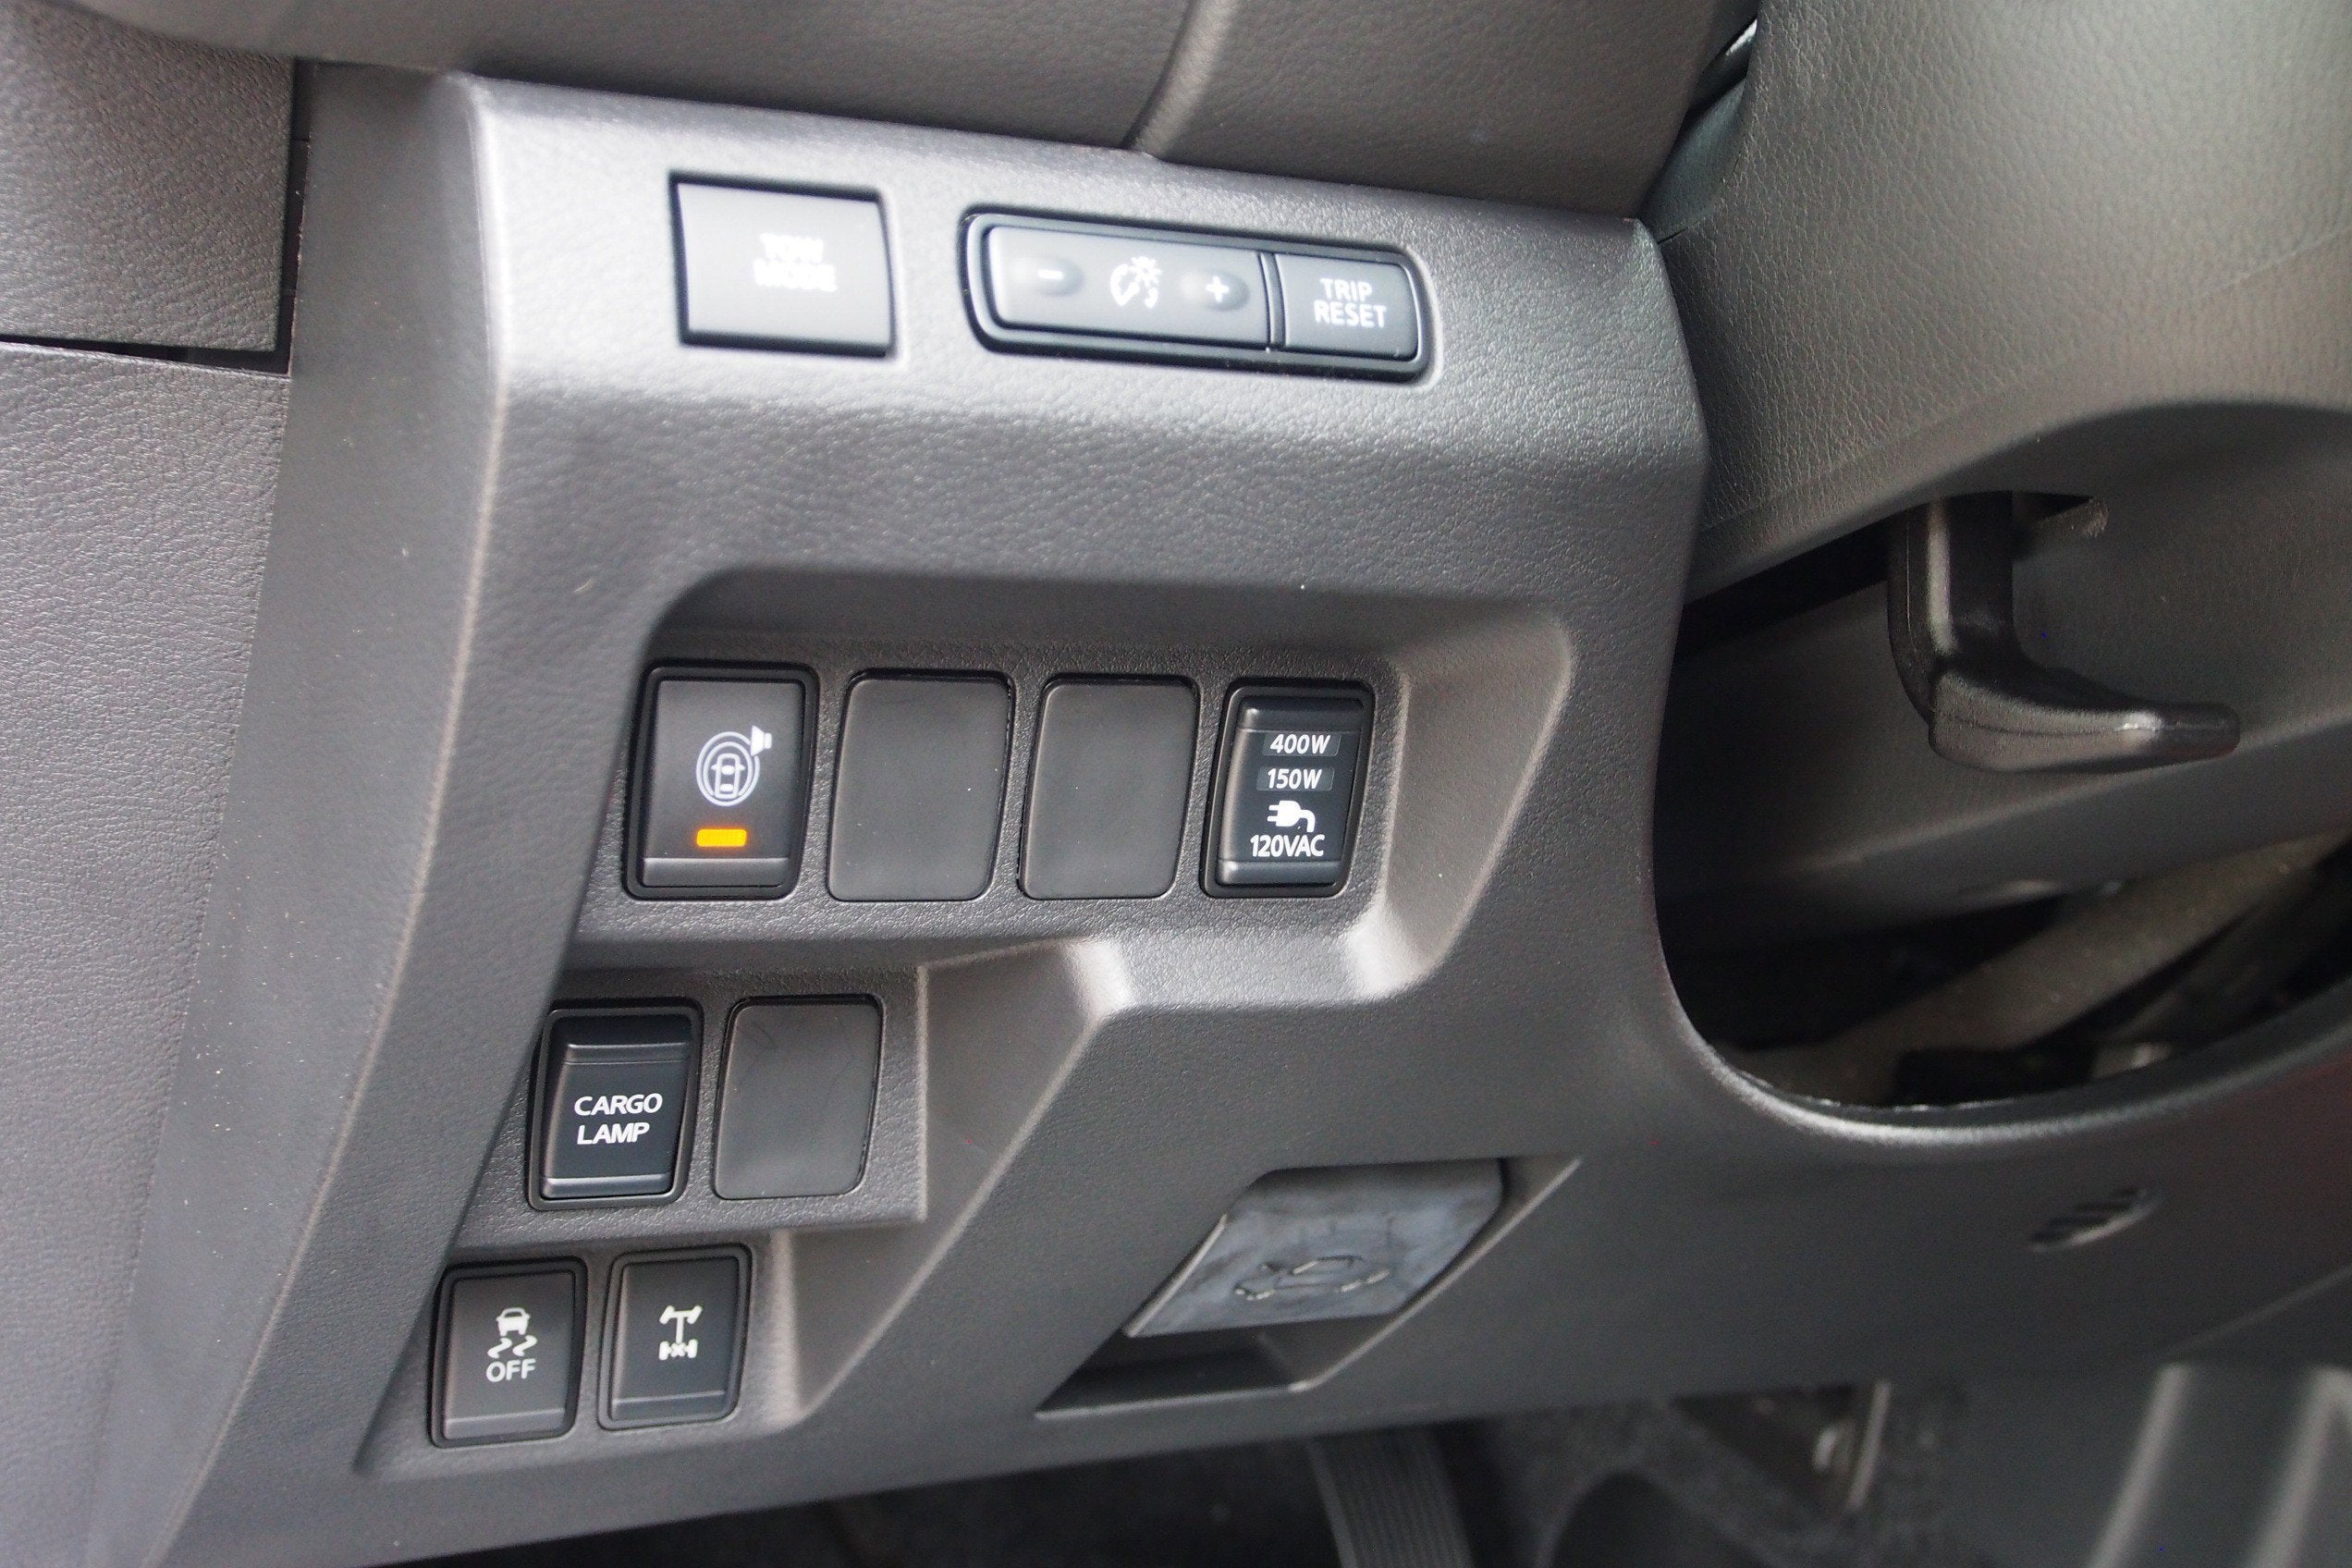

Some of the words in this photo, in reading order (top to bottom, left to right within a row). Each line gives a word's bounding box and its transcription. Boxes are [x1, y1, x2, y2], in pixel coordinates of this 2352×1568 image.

[1319, 277, 1373, 302] TRIP
[1313, 300, 1387, 328] RESET
[1269, 733, 1331, 754] 400W
[1268, 767, 1323, 790] 150W
[1250, 834, 1326, 858] 120VAC
[574, 1093, 663, 1116] CARGO
[577, 1121, 650, 1145] LAMP
[485, 1358, 536, 1383] OFF
